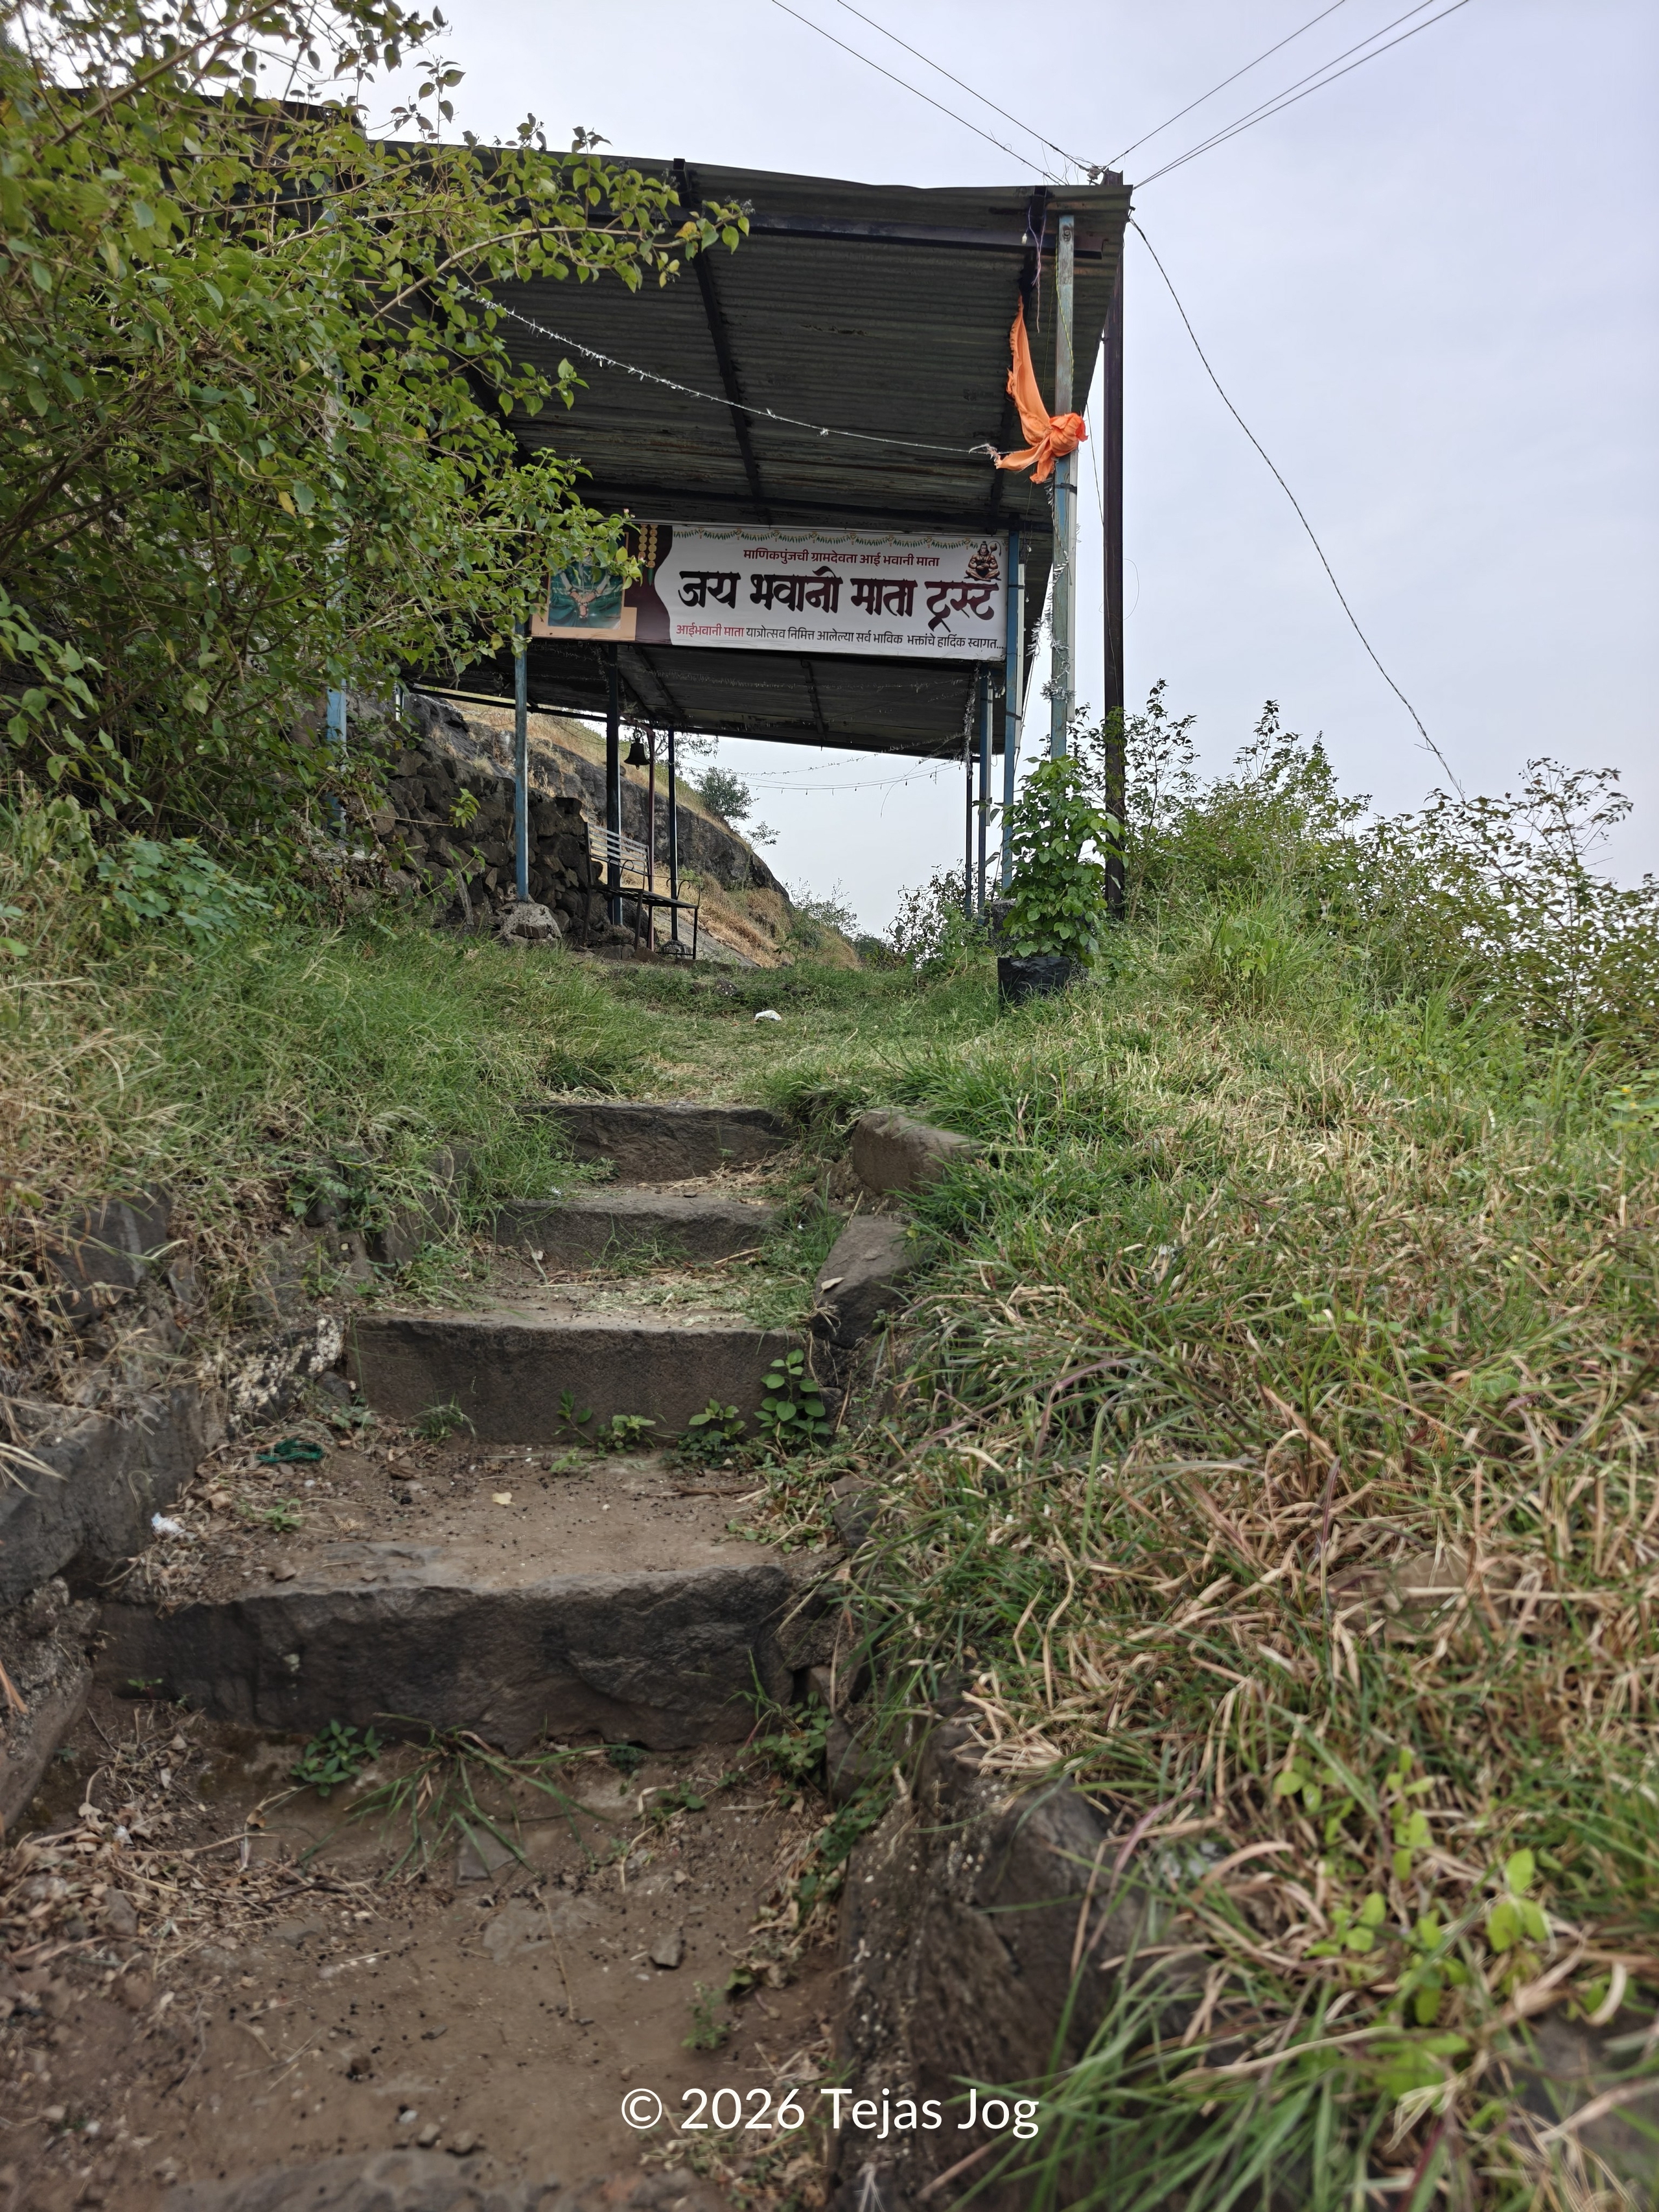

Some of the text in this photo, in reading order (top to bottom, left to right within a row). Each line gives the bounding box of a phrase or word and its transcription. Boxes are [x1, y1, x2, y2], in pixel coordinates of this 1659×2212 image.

[743, 548, 940, 567] माणिकपुंजची ग्रामदेवता आई भवानी माता
[678, 565, 999, 633] जय भवानी माता ट्रस्ट
[676, 622, 722, 637] आईभवानी
[724, 627, 745, 637] माता
[746, 625, 786, 639] यात्रोत्सव
[787, 626, 815, 640] निमित्त
[817, 628, 854, 642] आलेल्या
[856, 630, 871, 643] सर्व
[873, 631, 903, 644] भाविक
[907, 633, 936, 646] भक्तांचे
[937, 634, 966, 648] हार्दिक
